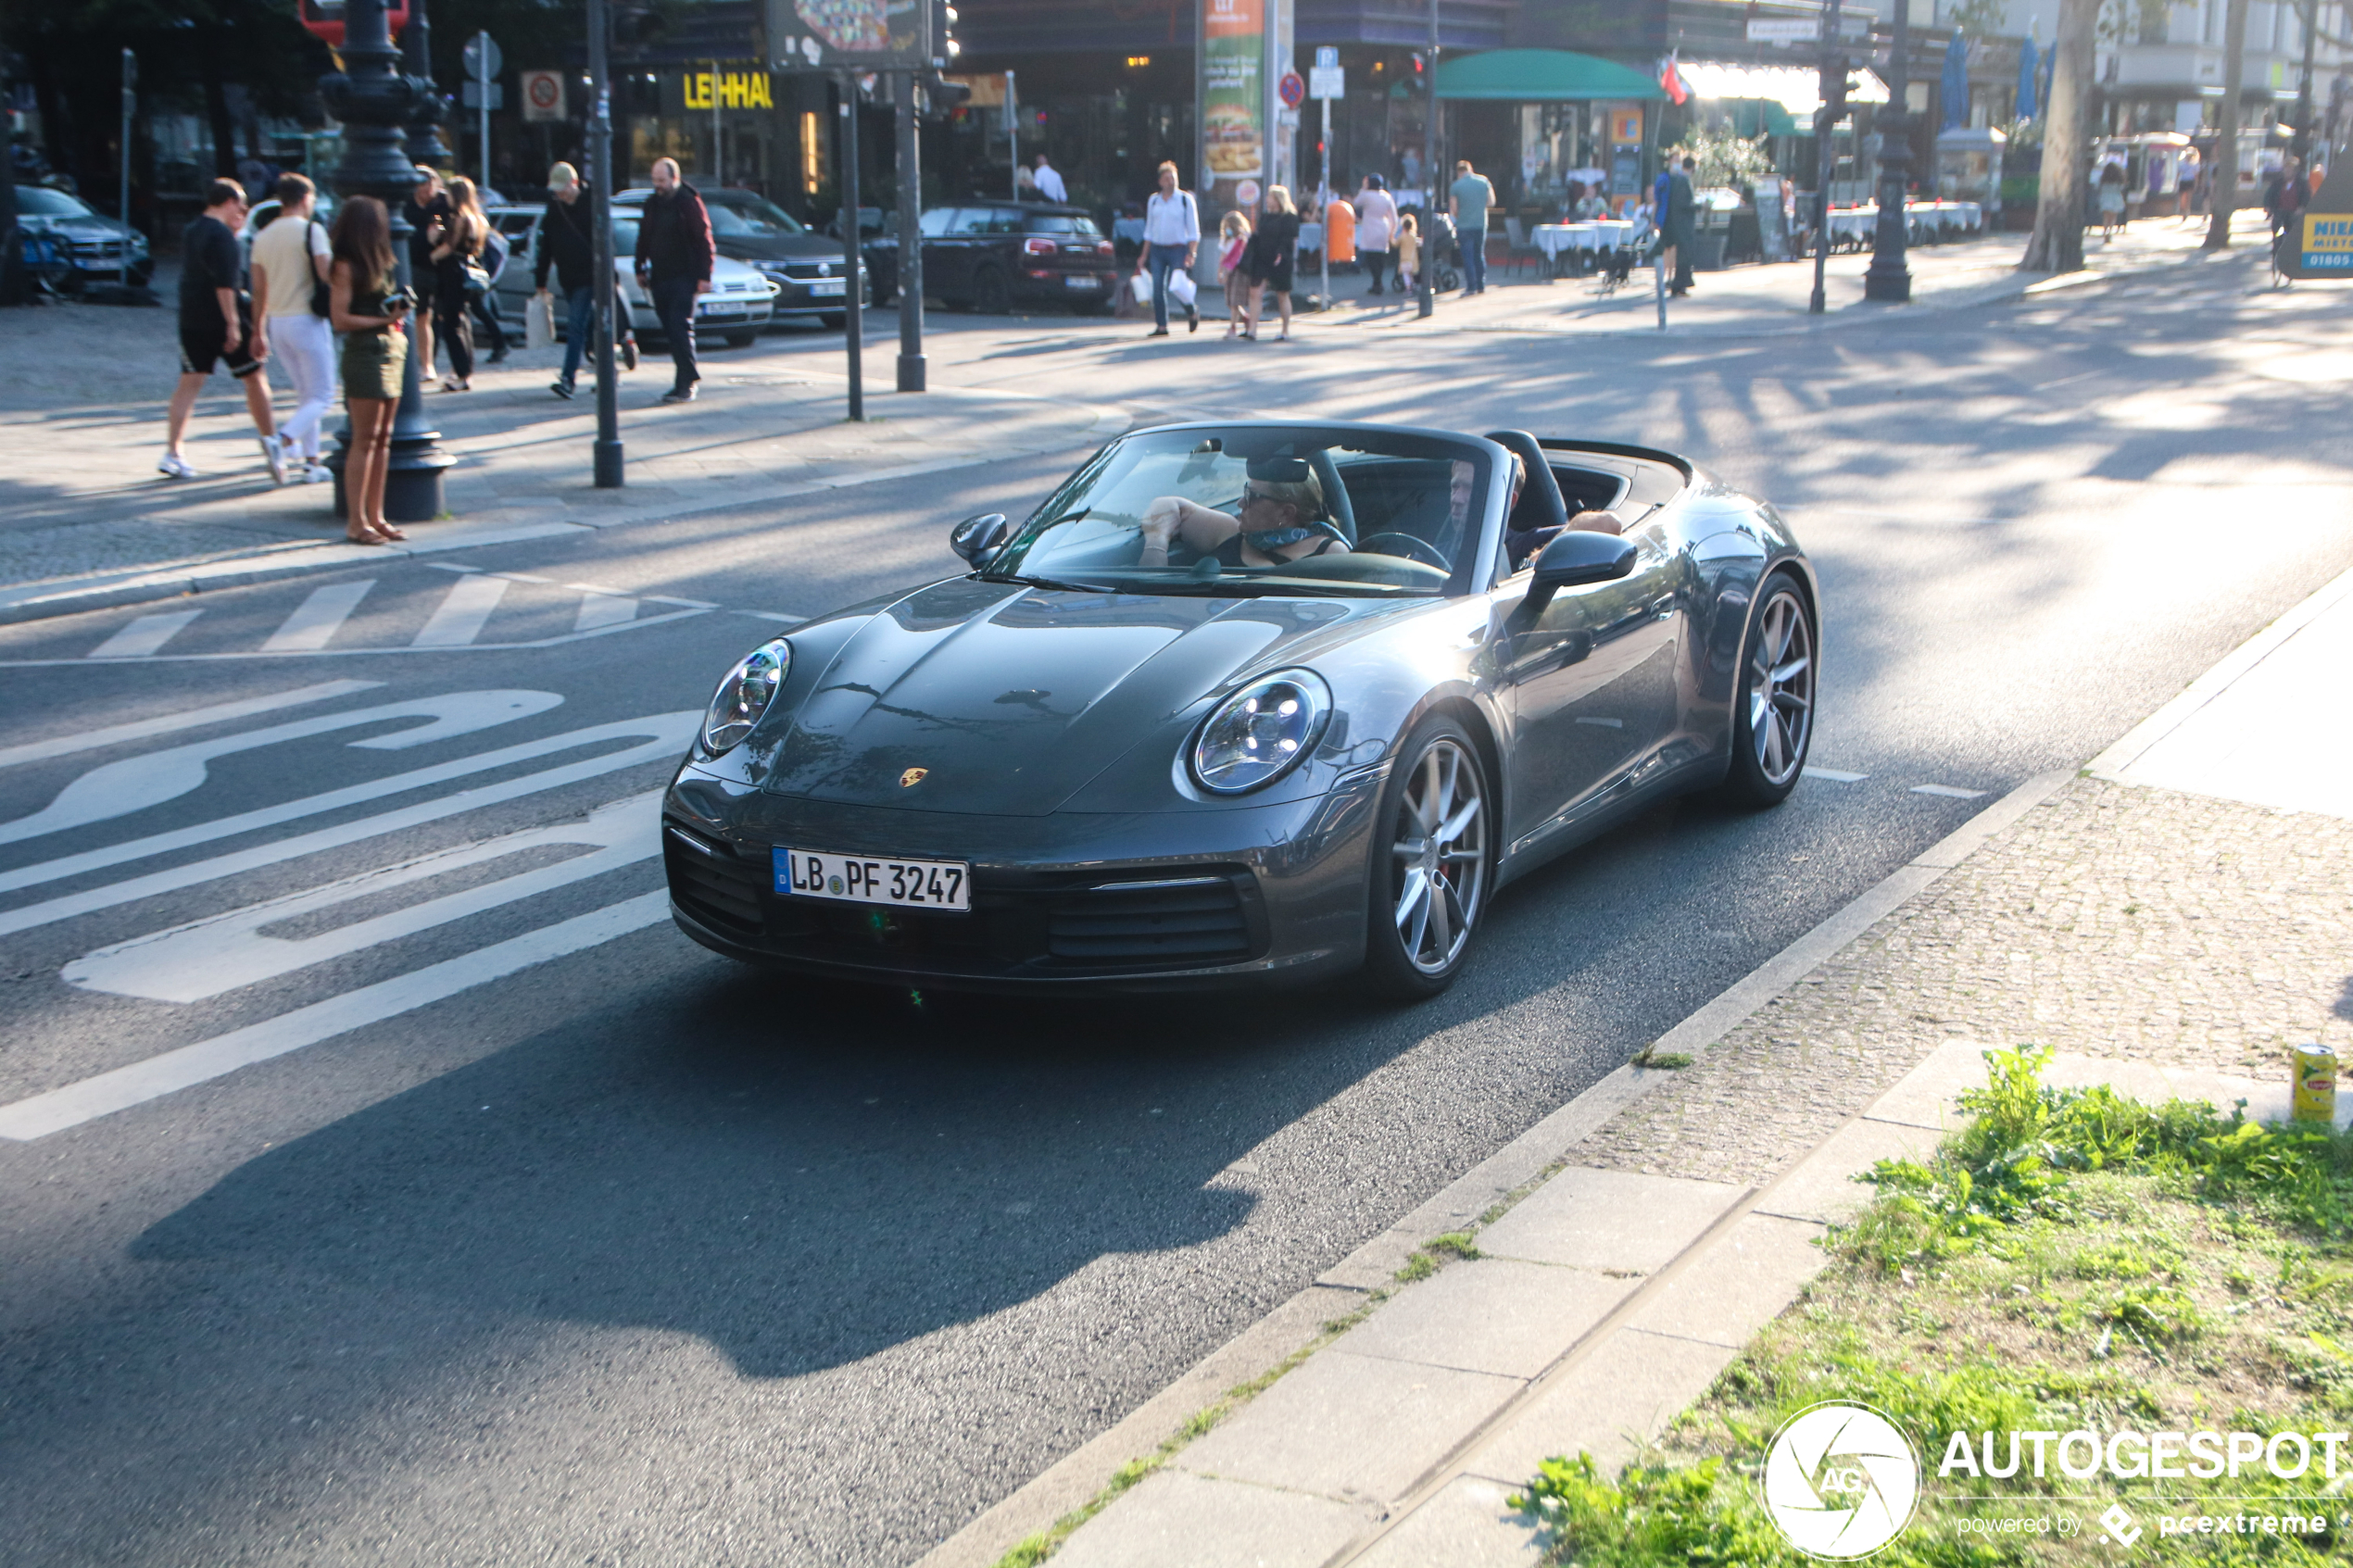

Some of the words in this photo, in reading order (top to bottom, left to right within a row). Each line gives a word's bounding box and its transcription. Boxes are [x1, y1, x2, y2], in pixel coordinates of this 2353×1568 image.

[791, 854, 824, 891] LB
[846, 860, 880, 897] PF
[888, 864, 963, 903] 3247
